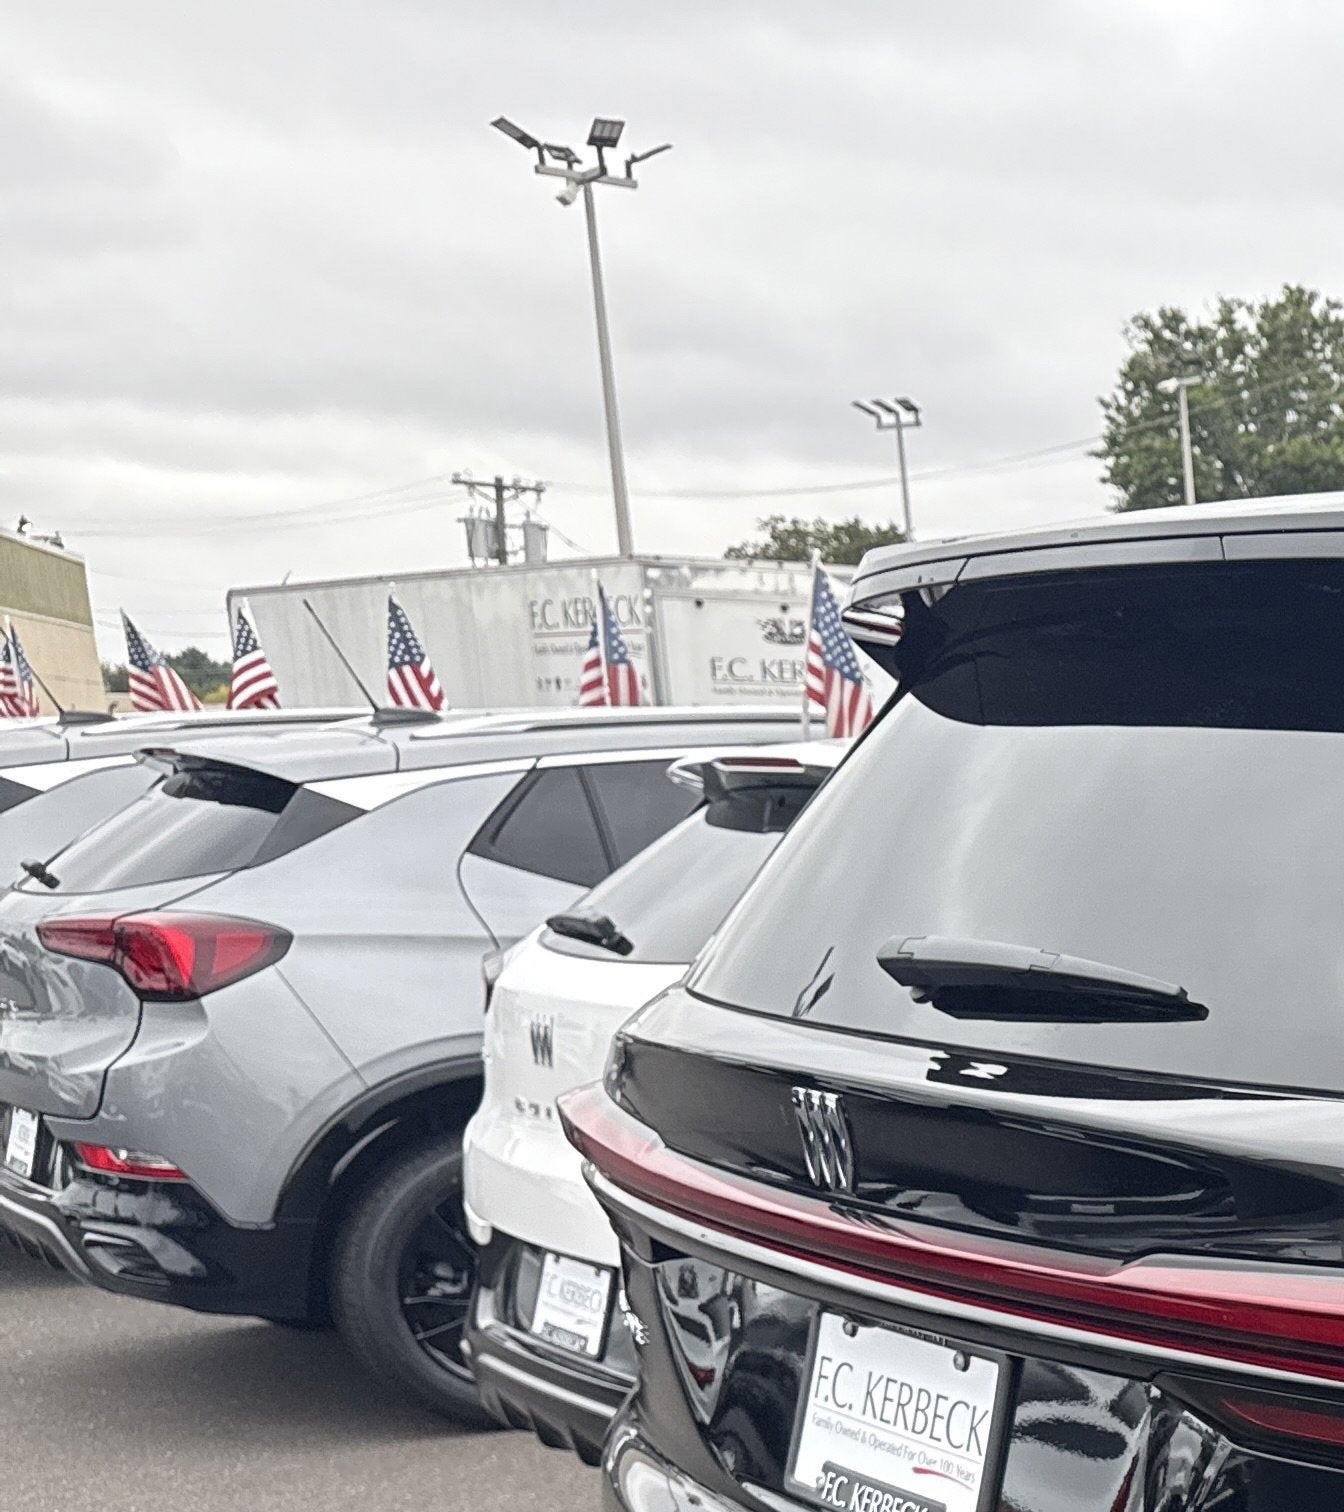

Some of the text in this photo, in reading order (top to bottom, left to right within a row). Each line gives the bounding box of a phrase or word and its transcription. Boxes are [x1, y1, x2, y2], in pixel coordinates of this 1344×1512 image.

[562, 594, 641, 629] KERCK
[814, 1355, 989, 1457] F.C. KERBECK
[903, 1445, 917, 1461] For
[917, 1451, 937, 1467] Over
[956, 1463, 976, 1483] Years
[820, 1471, 849, 1508] F.C.
